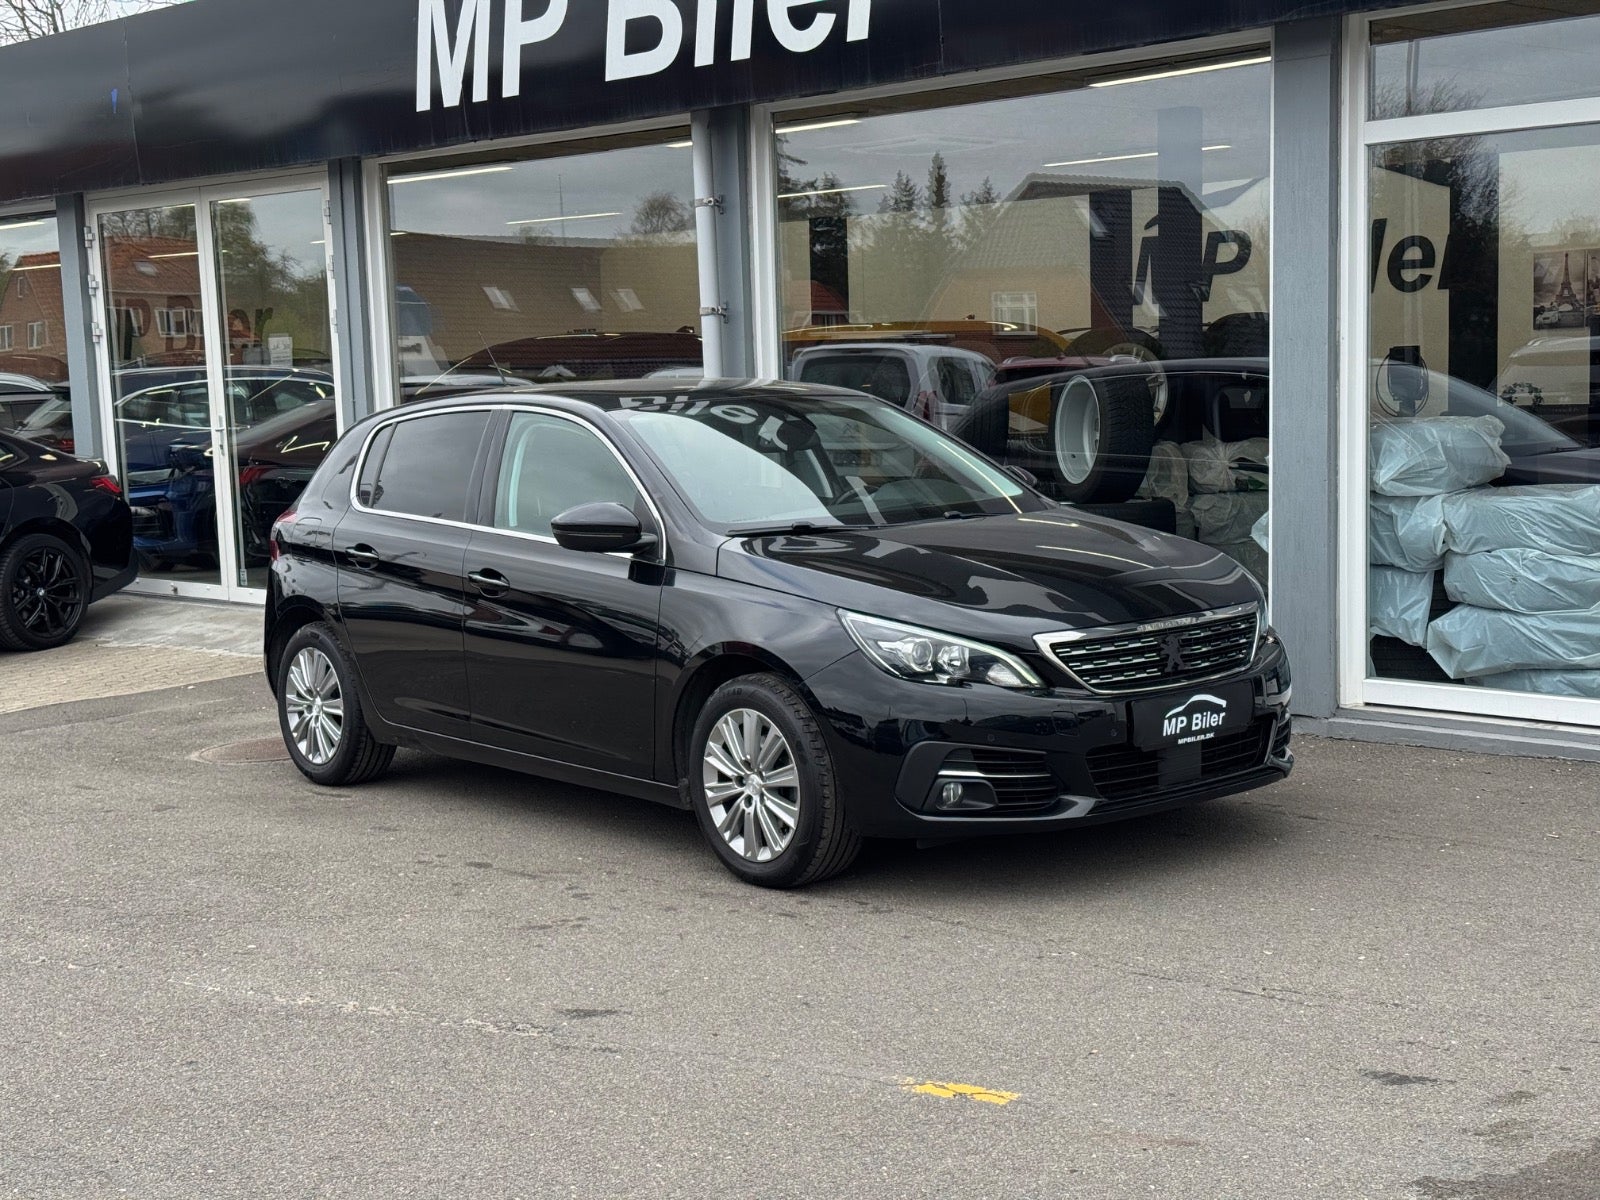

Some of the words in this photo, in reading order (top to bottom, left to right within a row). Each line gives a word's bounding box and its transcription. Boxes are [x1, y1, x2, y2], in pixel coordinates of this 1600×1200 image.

[1162, 716, 1188, 737] MP
[1191, 711, 1226, 731] Biler
[1177, 732, 1215, 745] MPBILER.DK
